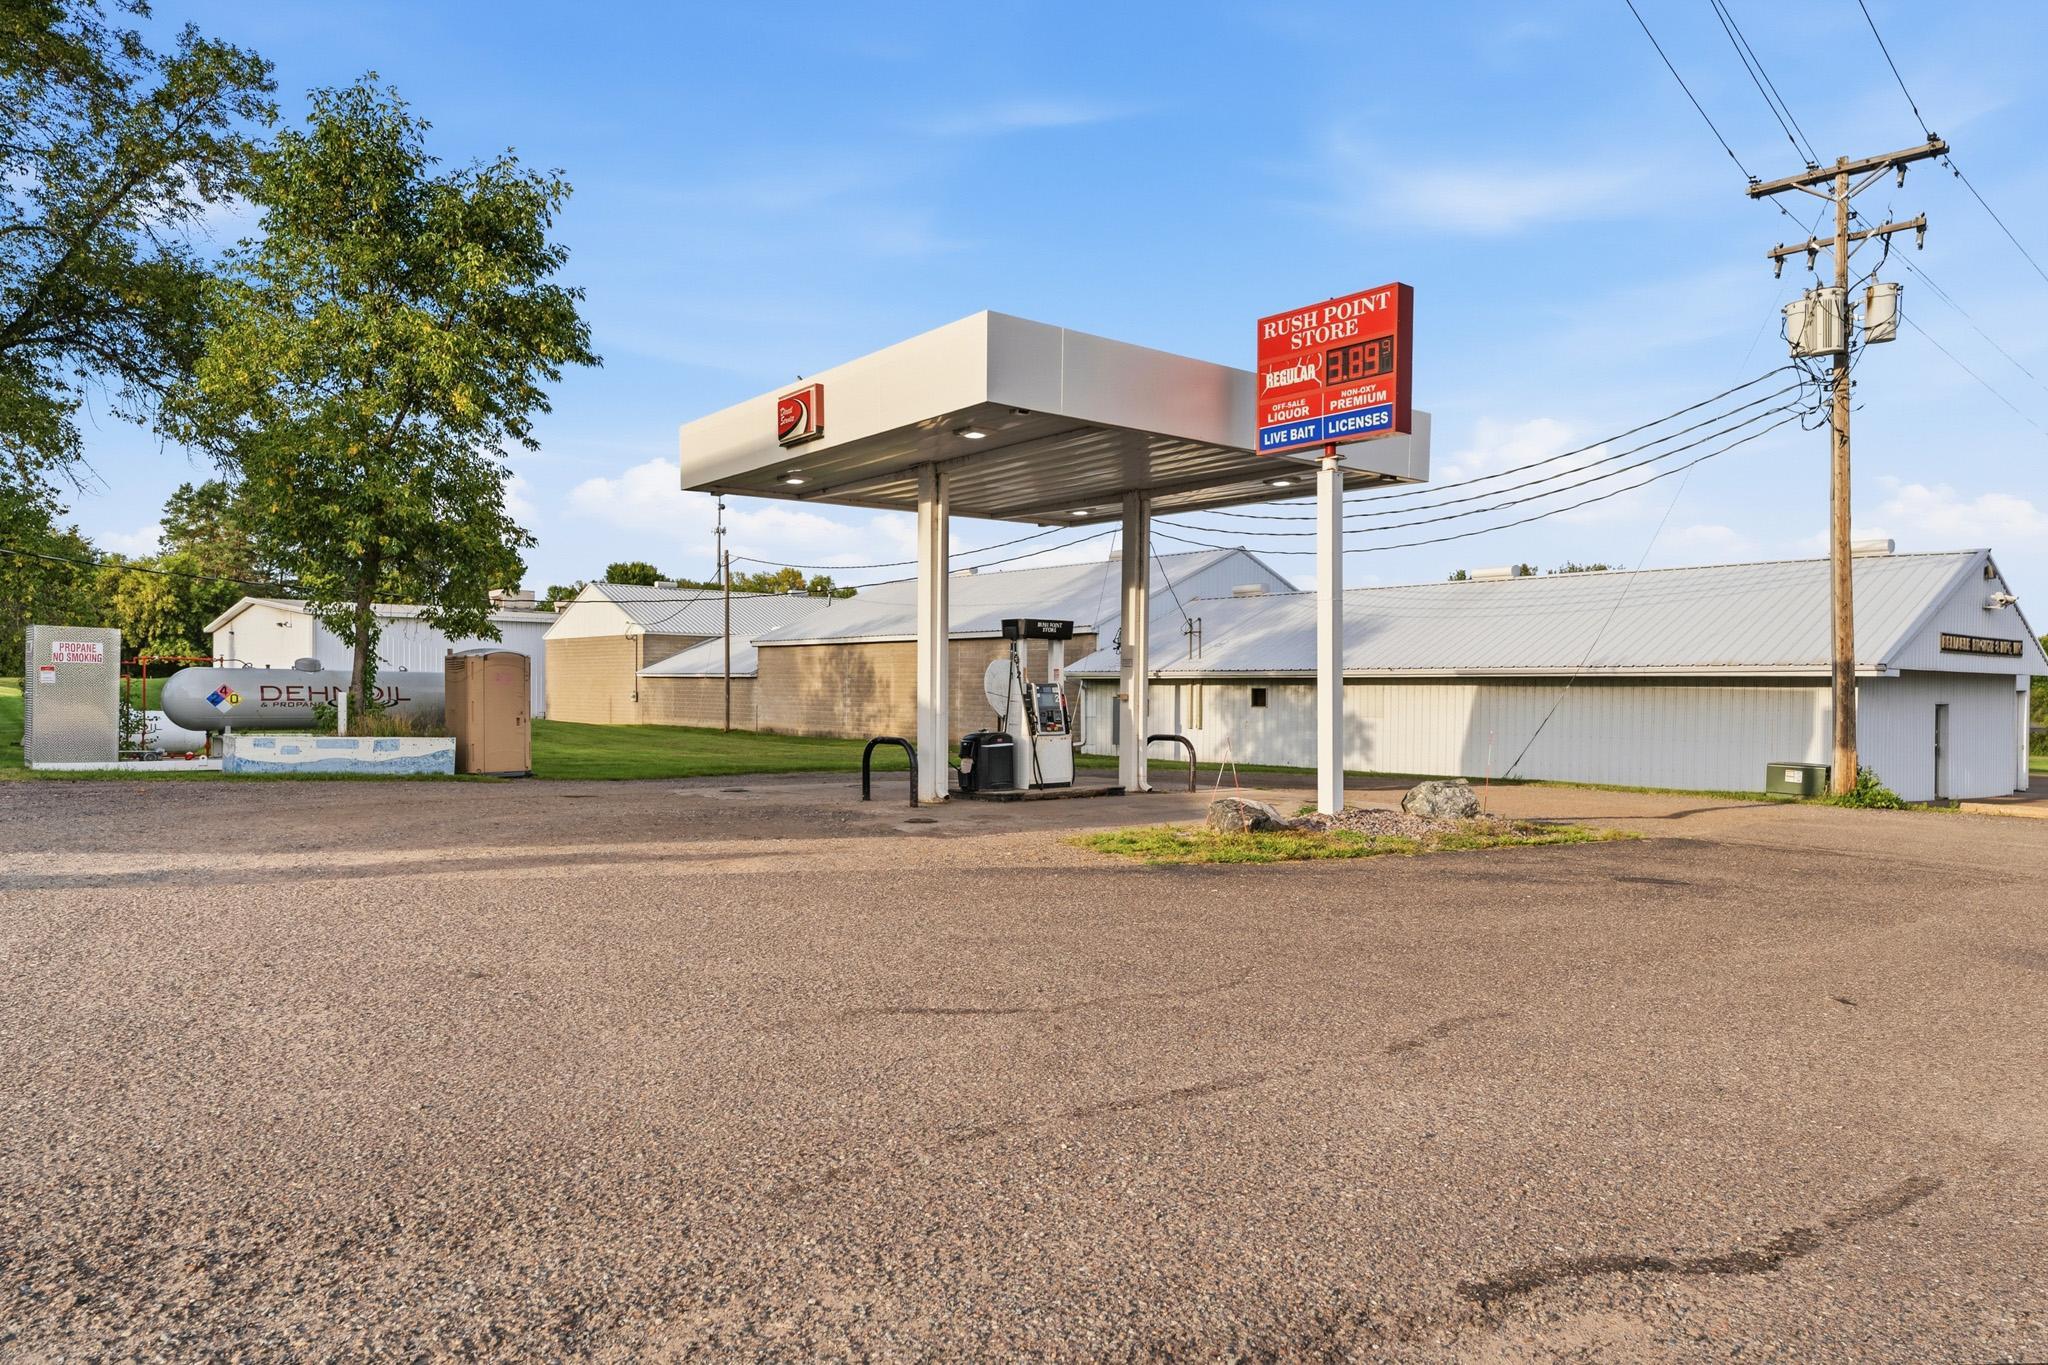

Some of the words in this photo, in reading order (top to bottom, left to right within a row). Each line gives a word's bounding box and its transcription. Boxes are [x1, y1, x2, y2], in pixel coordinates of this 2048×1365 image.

[1263, 310, 1318, 340] RUSH
[1323, 291, 1391, 324] POINT
[1290, 318, 1359, 350] STORE
[1266, 363, 1316, 389] REGULAR
[1341, 384, 1377, 397] NON-OXY
[1272, 398, 1306, 412] OFF-SALE
[1329, 390, 1387, 411] PREMIUM
[1267, 406, 1310, 423] LIQUOR
[1328, 411, 1389, 434] LICENSES
[1264, 431, 1288, 446] LIVE
[1290, 425, 1316, 441] BAIT
[59, 642, 97, 653] PROPANE
[53, 652, 64, 662] NO
[66, 652, 102, 663] SMOKING
[219, 685, 228, 696] 4
